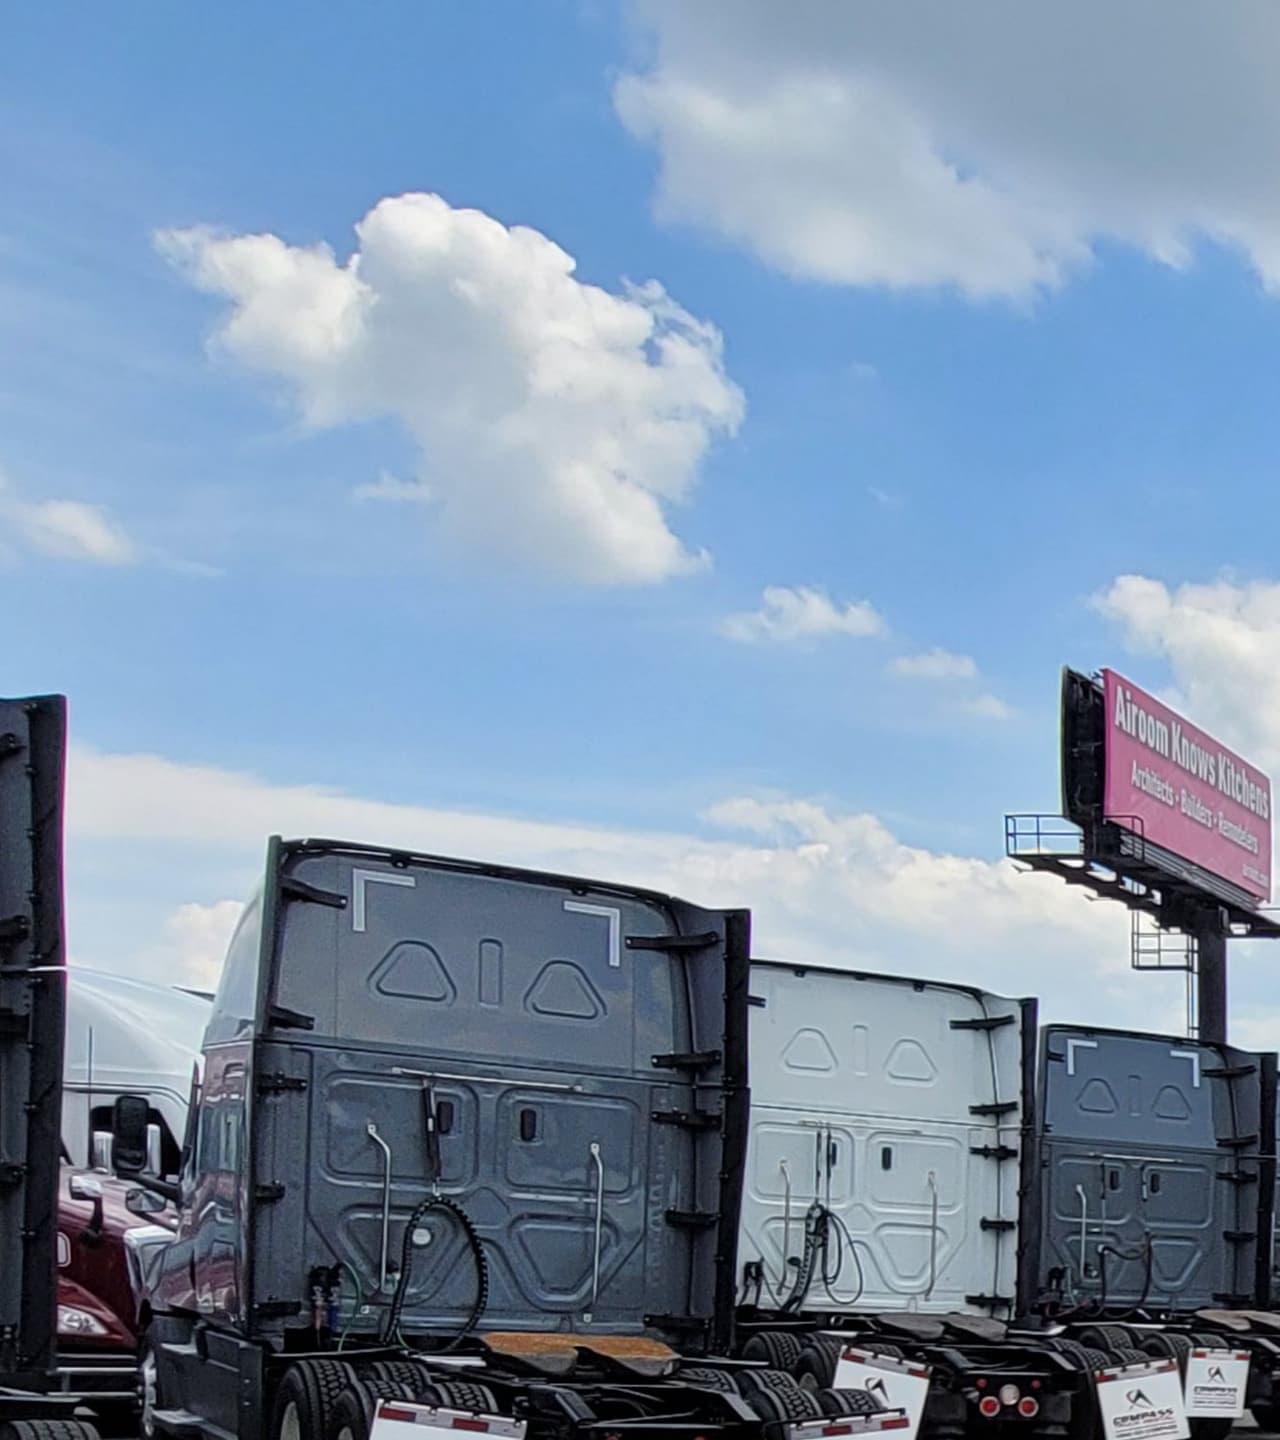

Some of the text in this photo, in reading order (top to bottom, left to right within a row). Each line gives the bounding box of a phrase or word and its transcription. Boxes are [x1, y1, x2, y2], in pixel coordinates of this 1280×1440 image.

[1115, 685, 1269, 820] Airoom Knows Kitchens
[1131, 759, 1175, 807] Architects
[1181, 788, 1213, 829] Builders
